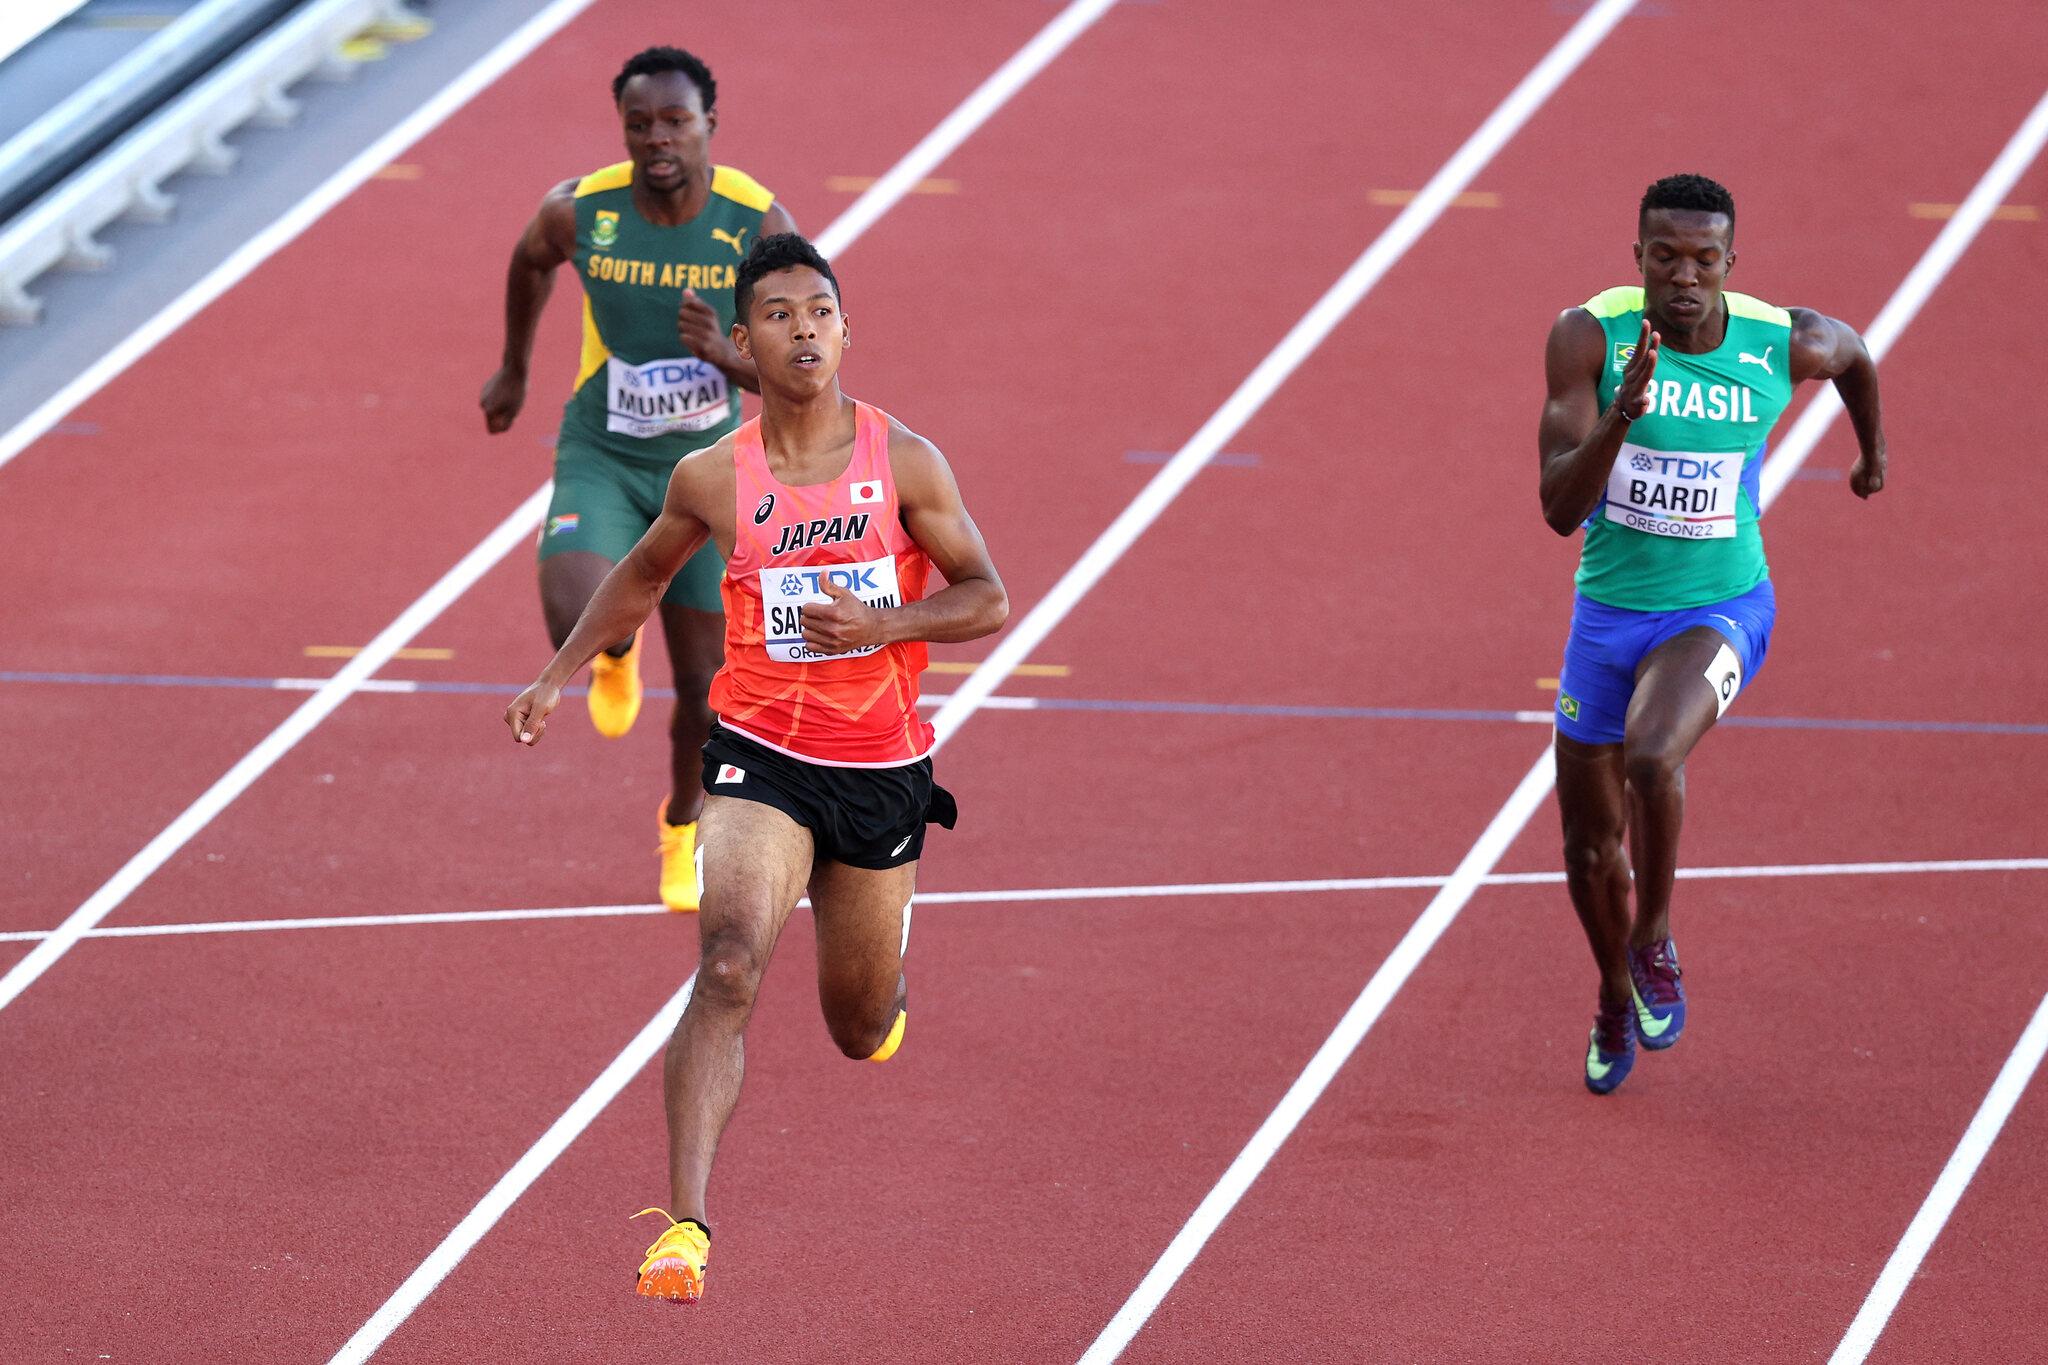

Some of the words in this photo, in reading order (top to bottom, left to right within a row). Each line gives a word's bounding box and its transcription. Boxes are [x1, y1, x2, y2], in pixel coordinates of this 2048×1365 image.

[587, 255, 656, 286] SOUTH
[660, 264, 737, 289] AFRICA
[641, 363, 706, 387] TDK
[618, 380, 719, 417] MUNYAI
[1640, 380, 1758, 423] BRASIL
[1654, 457, 1724, 480] TDK
[1629, 479, 1717, 513] BARDI
[771, 513, 870, 556] JAPAN
[1625, 513, 1714, 537] OREGON22
[802, 567, 879, 594] TDK
[1721, 671, 1736, 701] 6
